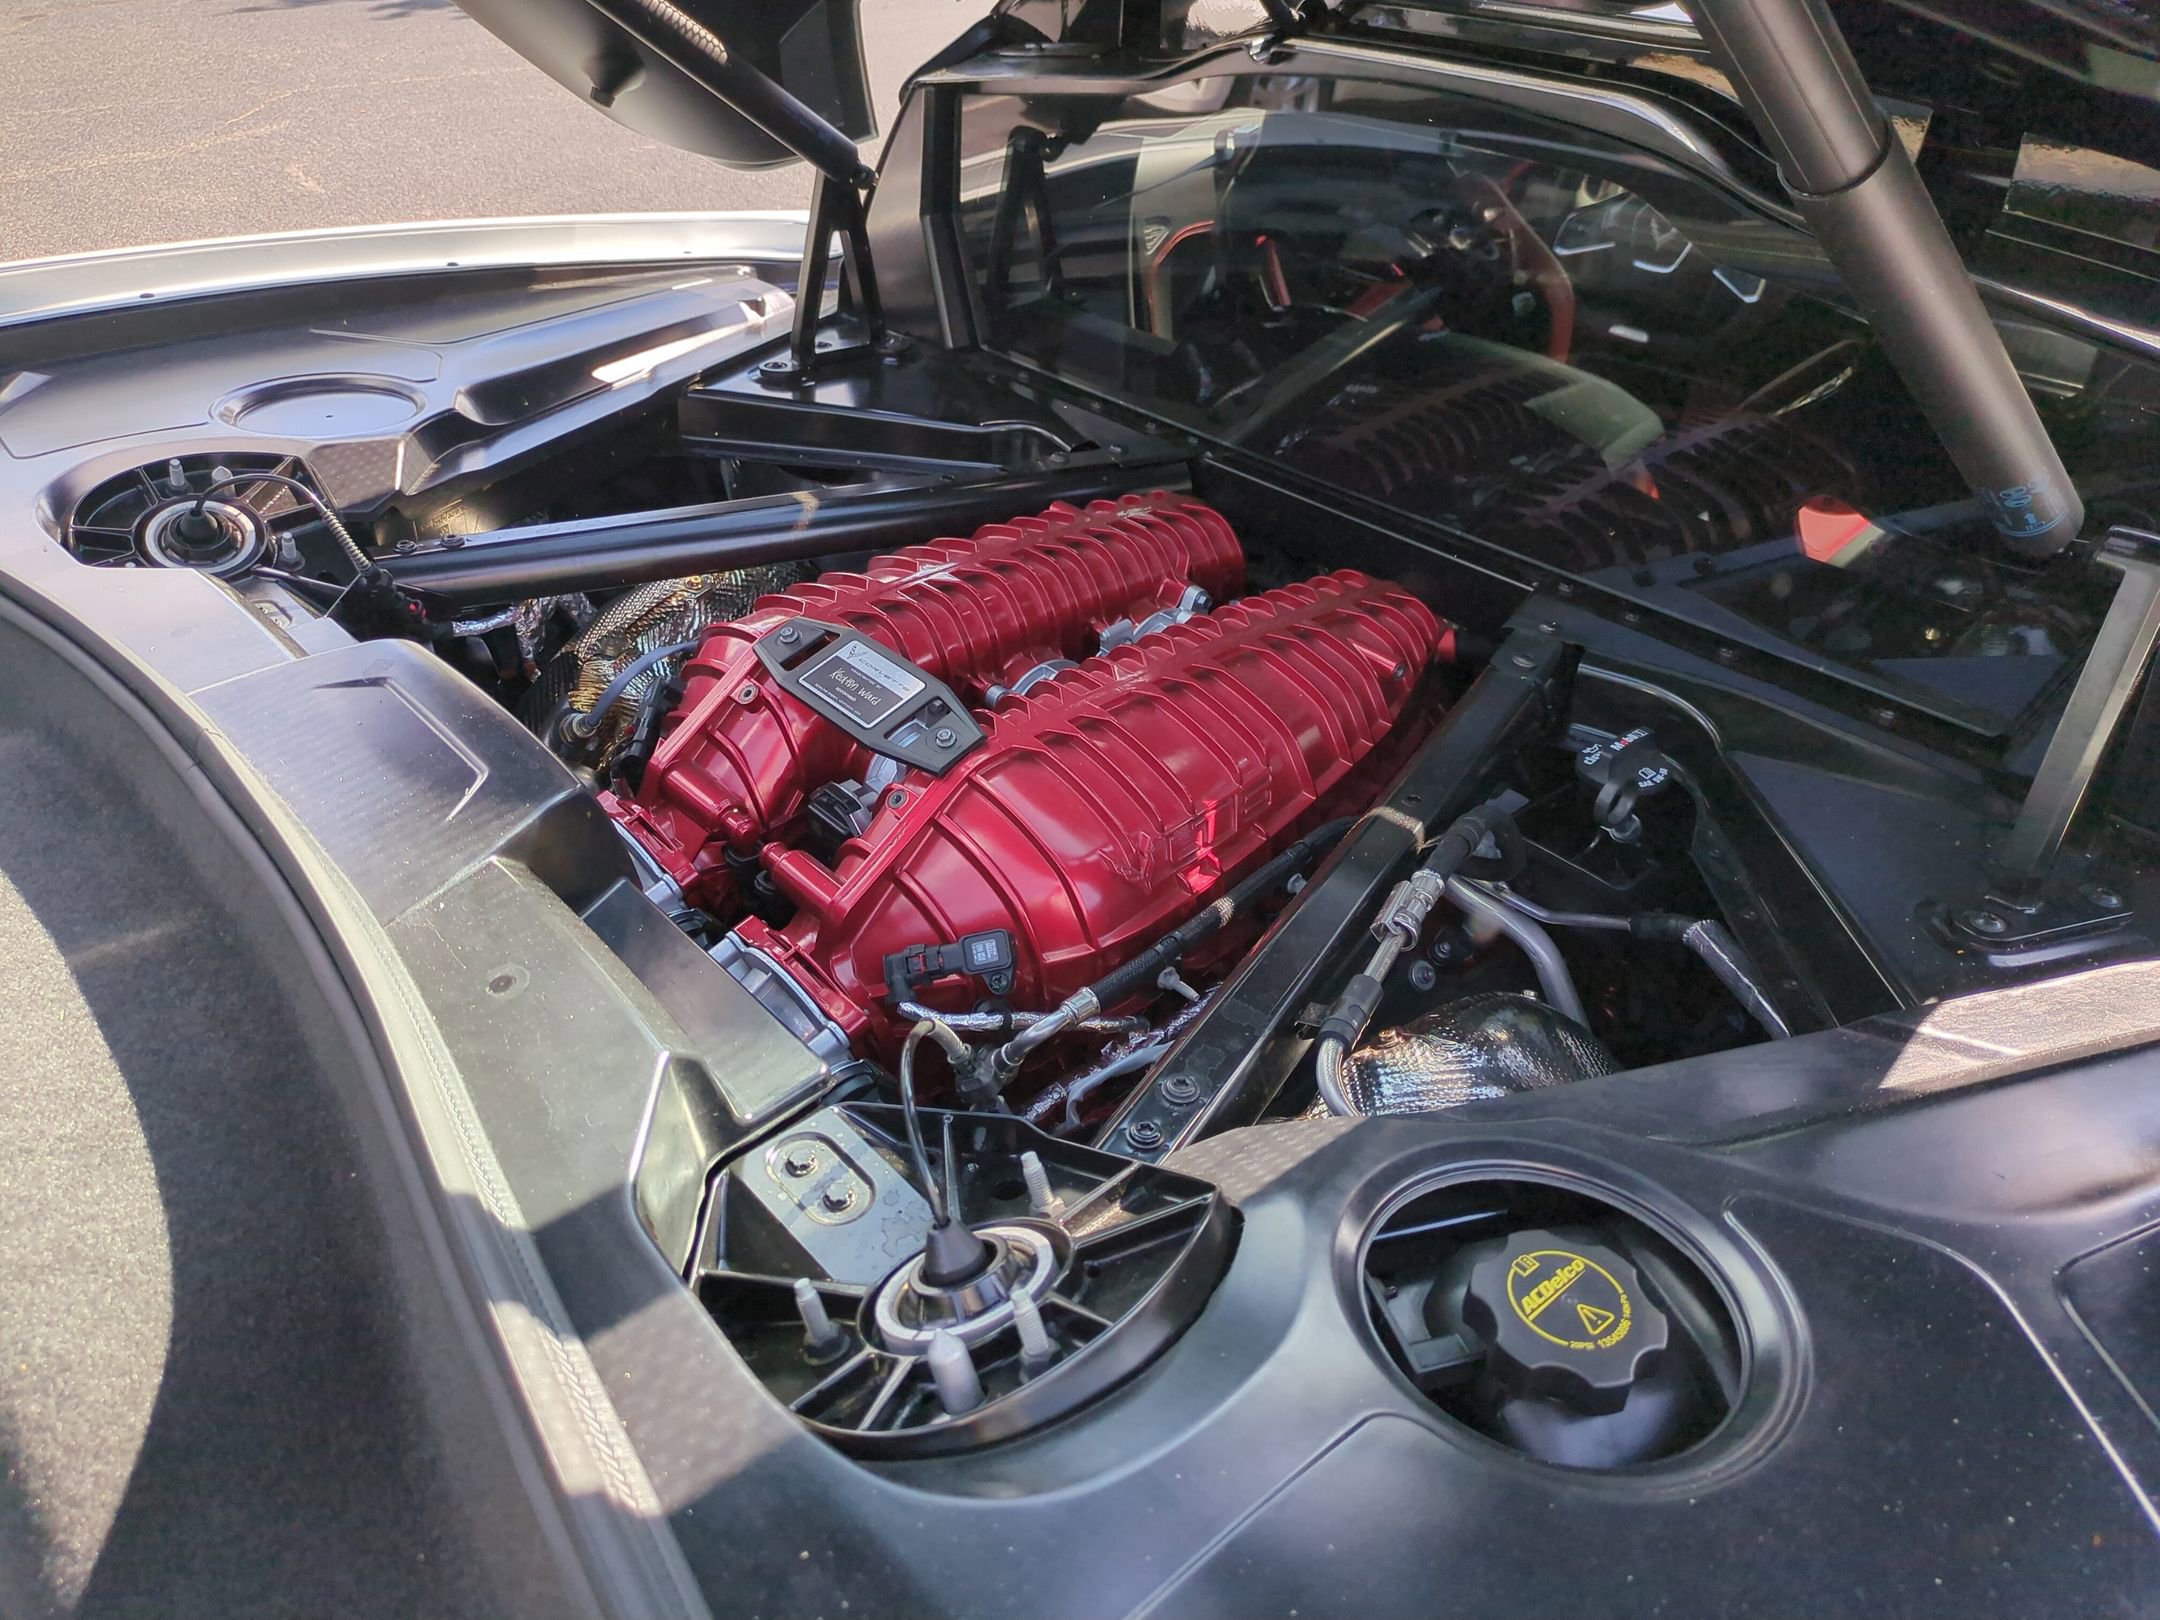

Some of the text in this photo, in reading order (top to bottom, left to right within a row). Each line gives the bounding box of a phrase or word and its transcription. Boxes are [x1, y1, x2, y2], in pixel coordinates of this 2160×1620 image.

[858, 658, 911, 692] CORVETTE
[1610, 733, 1638, 750] Mobil
[1521, 1258, 1585, 1315] ACDelco
